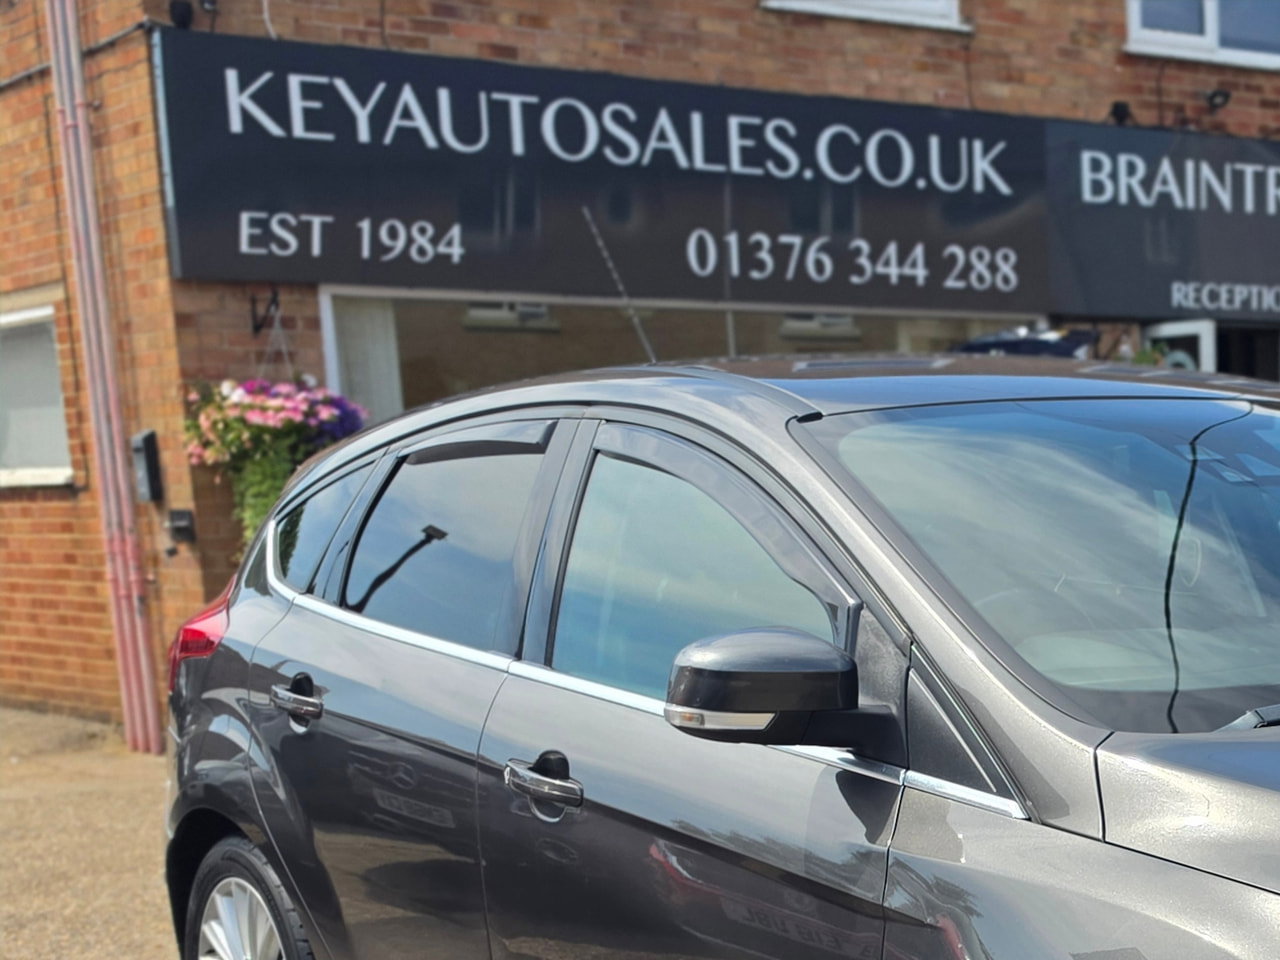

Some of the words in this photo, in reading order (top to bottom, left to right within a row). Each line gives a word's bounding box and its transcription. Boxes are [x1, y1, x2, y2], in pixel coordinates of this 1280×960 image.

[224, 67, 1014, 196] KEYAUTOSALES.CO.UK
[239, 211, 335, 257] EST
[356, 218, 466, 264] 1984
[686, 228, 834, 282] 01376
[849, 237, 930, 286] 344
[942, 244, 1019, 292] 288
